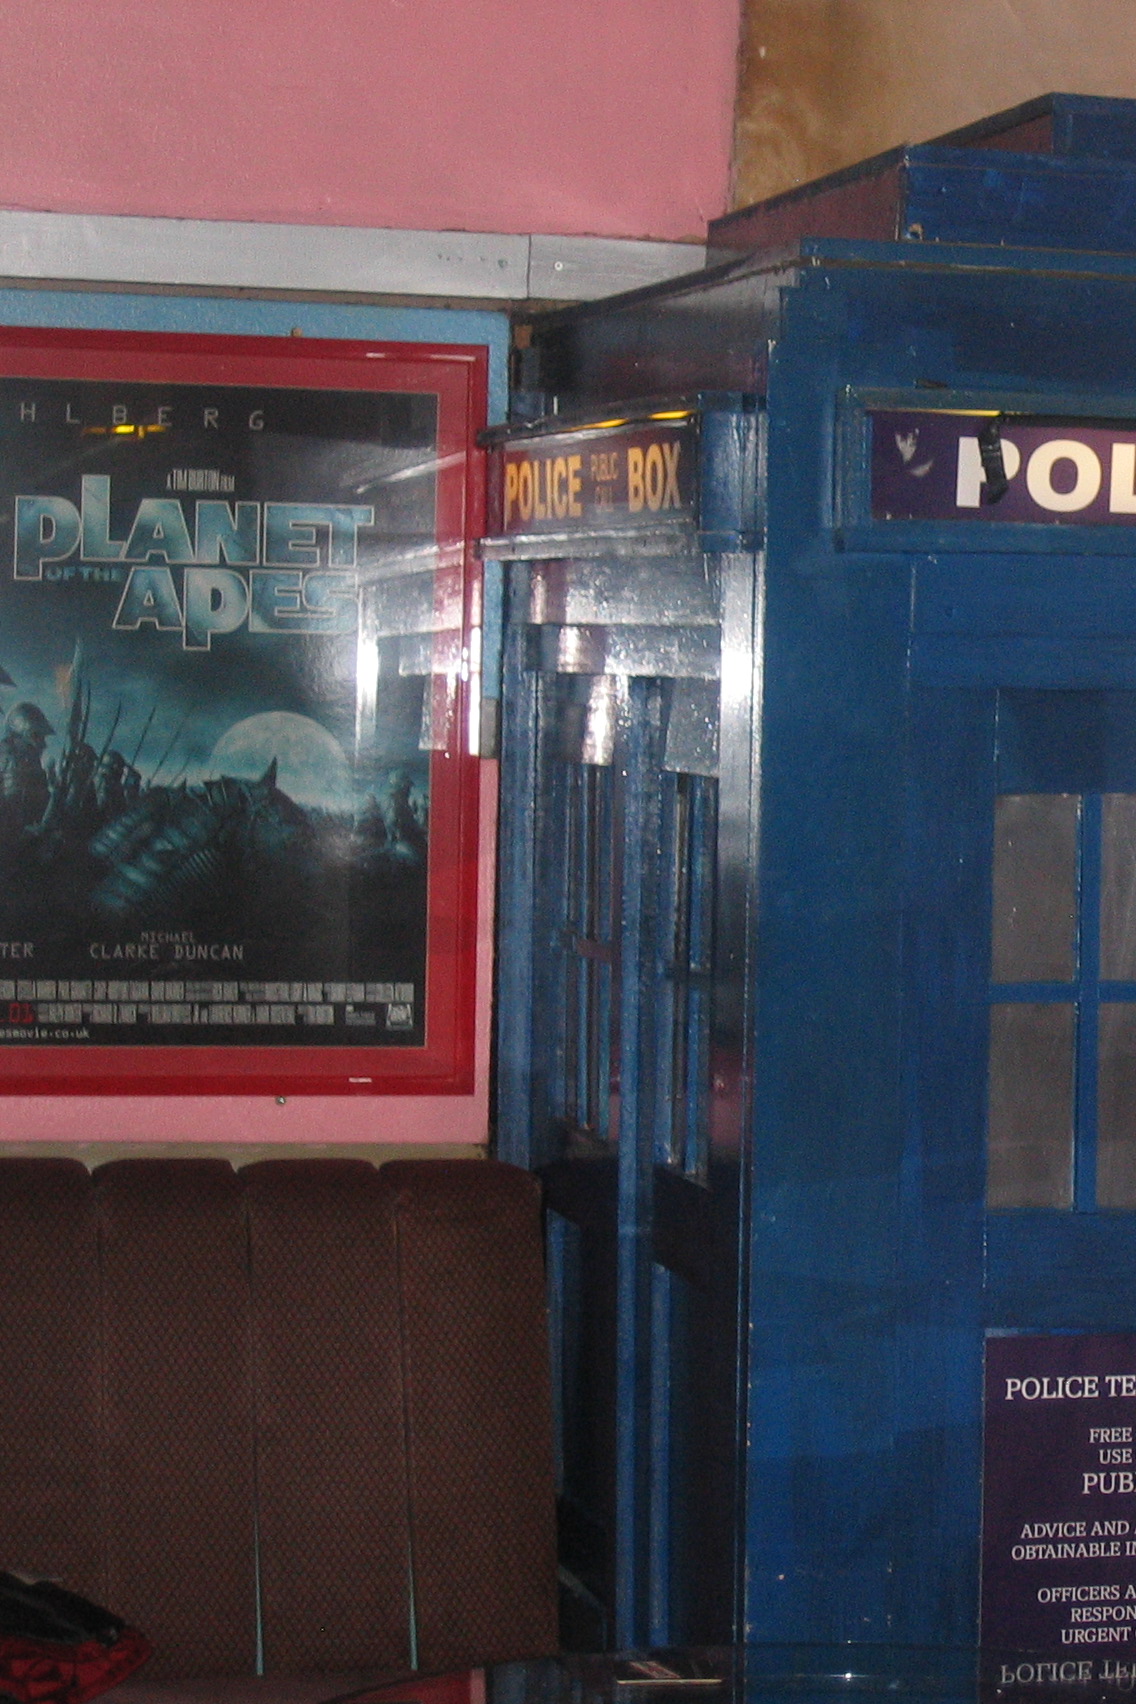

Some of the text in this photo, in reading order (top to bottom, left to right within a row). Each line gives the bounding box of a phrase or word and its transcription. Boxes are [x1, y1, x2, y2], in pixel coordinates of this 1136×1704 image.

[627, 440, 682, 513] BOX
[504, 454, 583, 522] POLICE
[14, 474, 375, 580] PLANET
[112, 566, 359, 651] APES
[89, 943, 244, 961] CLARKE DUNCAN
[1005, 1376, 1099, 1400] POLICE
[1089, 1427, 1132, 1443] FREE
[1099, 1449, 1132, 1464] USE
[1020, 1521, 1087, 1539] ADVICE
[1091, 1520, 1130, 1536] AND
[1011, 1541, 1121, 1560] OBTAINABLE
[1037, 1585, 1121, 1603] OFFICERS
[1061, 1627, 1132, 1644] URGENT
